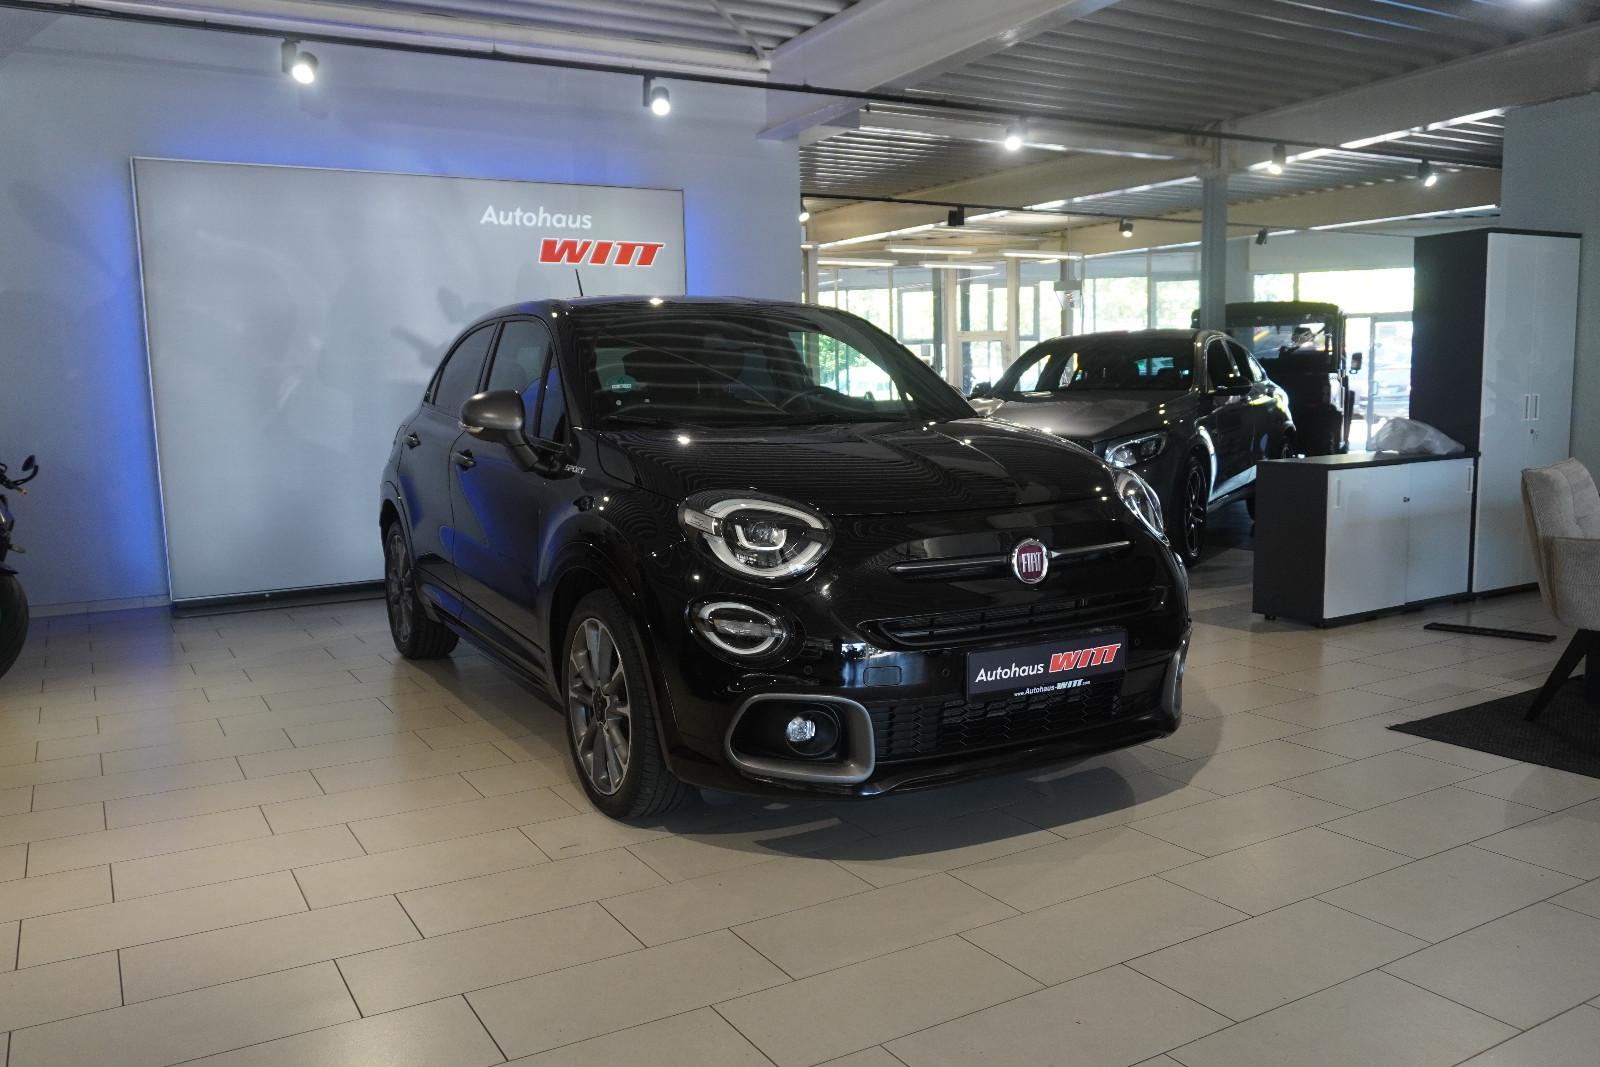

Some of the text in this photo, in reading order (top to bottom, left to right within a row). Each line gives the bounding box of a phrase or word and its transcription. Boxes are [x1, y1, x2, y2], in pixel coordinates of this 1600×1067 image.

[480, 205, 592, 229] Autohaus
[538, 238, 666, 267] WITT
[1021, 551, 1042, 573] FIAT
[974, 643, 1122, 683] Autohaus WITT
